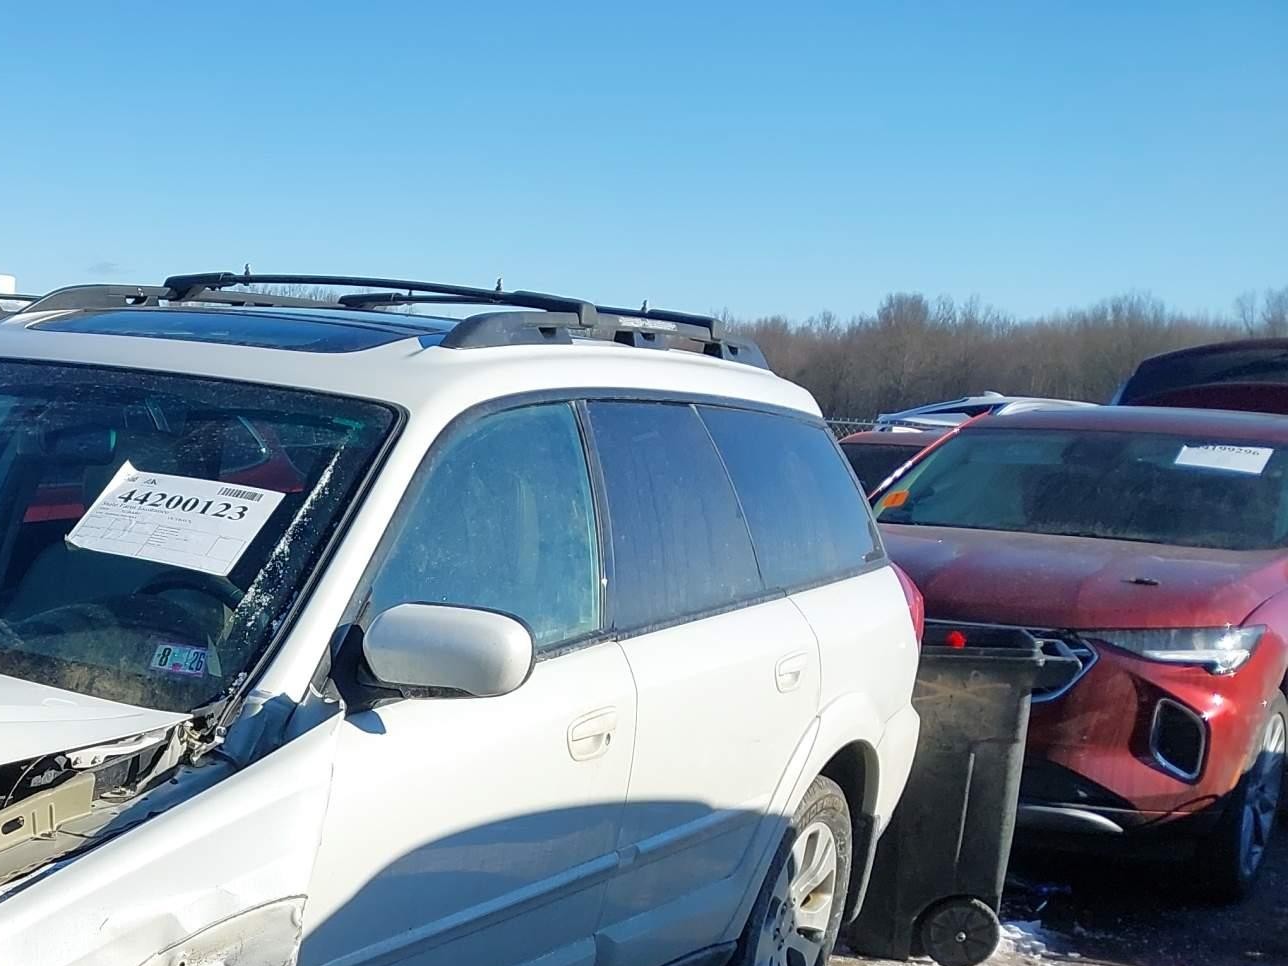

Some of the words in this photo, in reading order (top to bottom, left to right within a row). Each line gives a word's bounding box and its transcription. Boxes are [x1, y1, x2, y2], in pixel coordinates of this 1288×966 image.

[118, 489, 248, 521] 44200123
[158, 647, 172, 666] 8
[188, 650, 206, 671] 26
